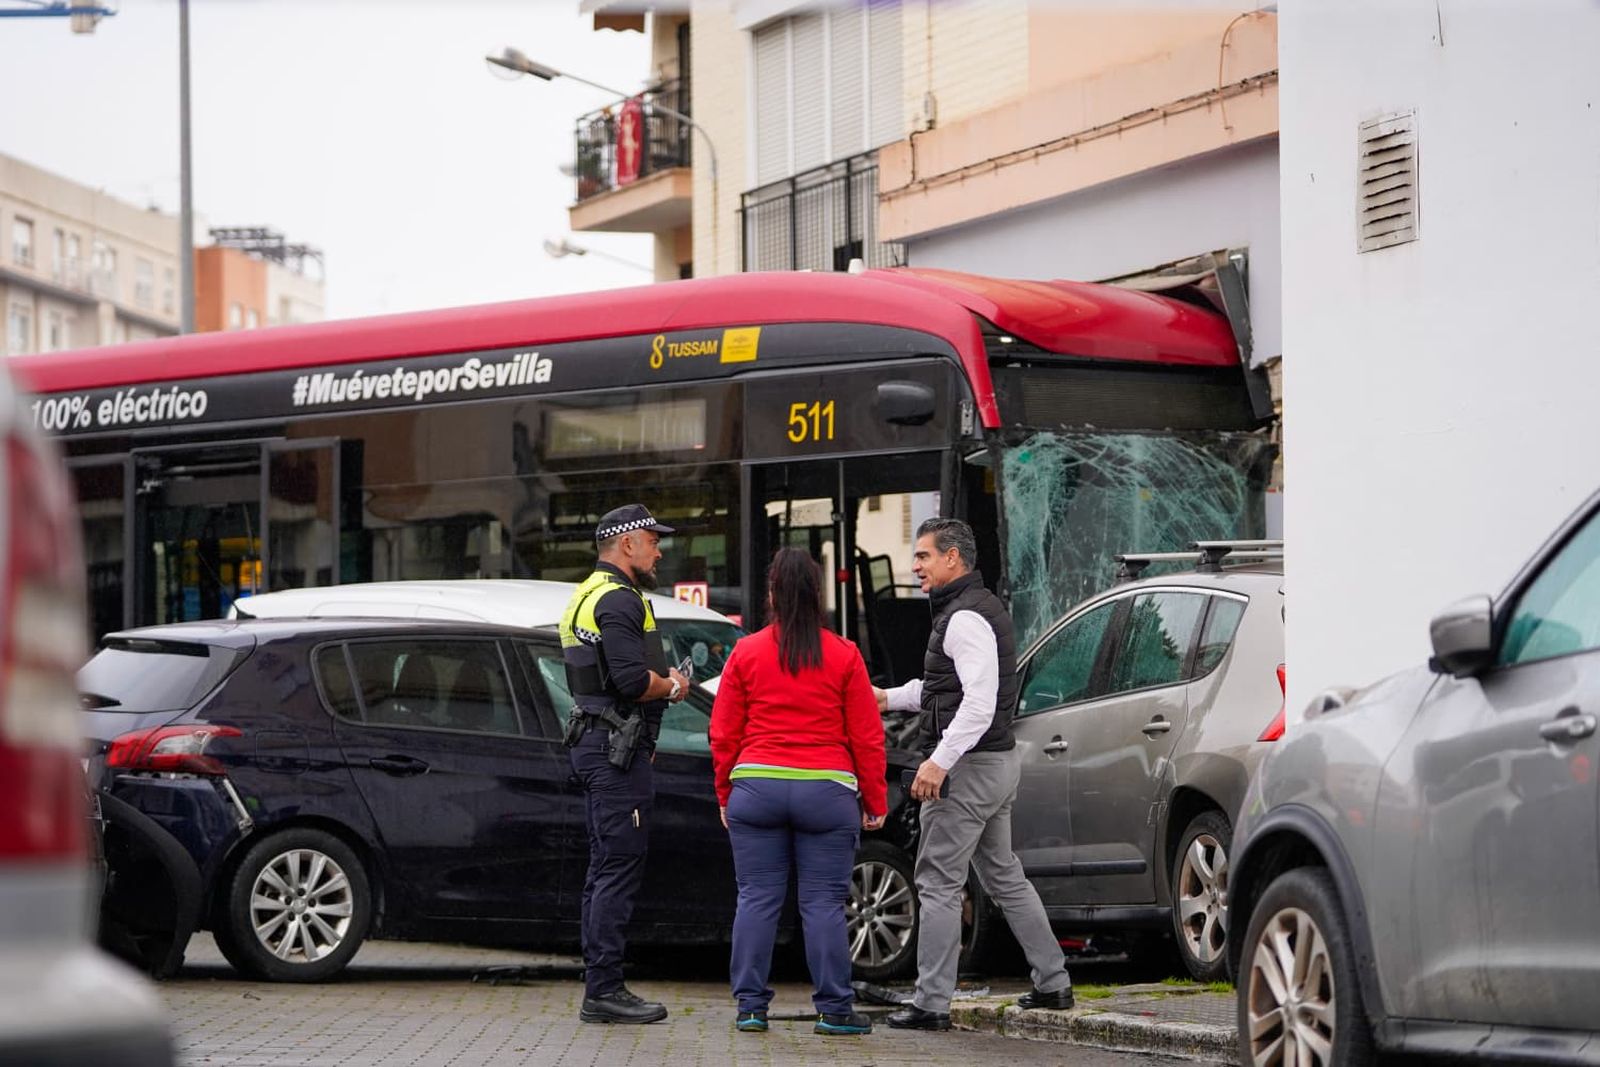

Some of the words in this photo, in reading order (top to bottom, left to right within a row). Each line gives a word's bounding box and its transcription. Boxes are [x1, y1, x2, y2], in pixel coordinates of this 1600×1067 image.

[667, 339, 718, 358] TUSSAM
[292, 352, 553, 406] #MuéveteporSevilla
[31, 395, 92, 430] 100%
[97, 385, 208, 426] eléctrico
[787, 400, 835, 443] 511
